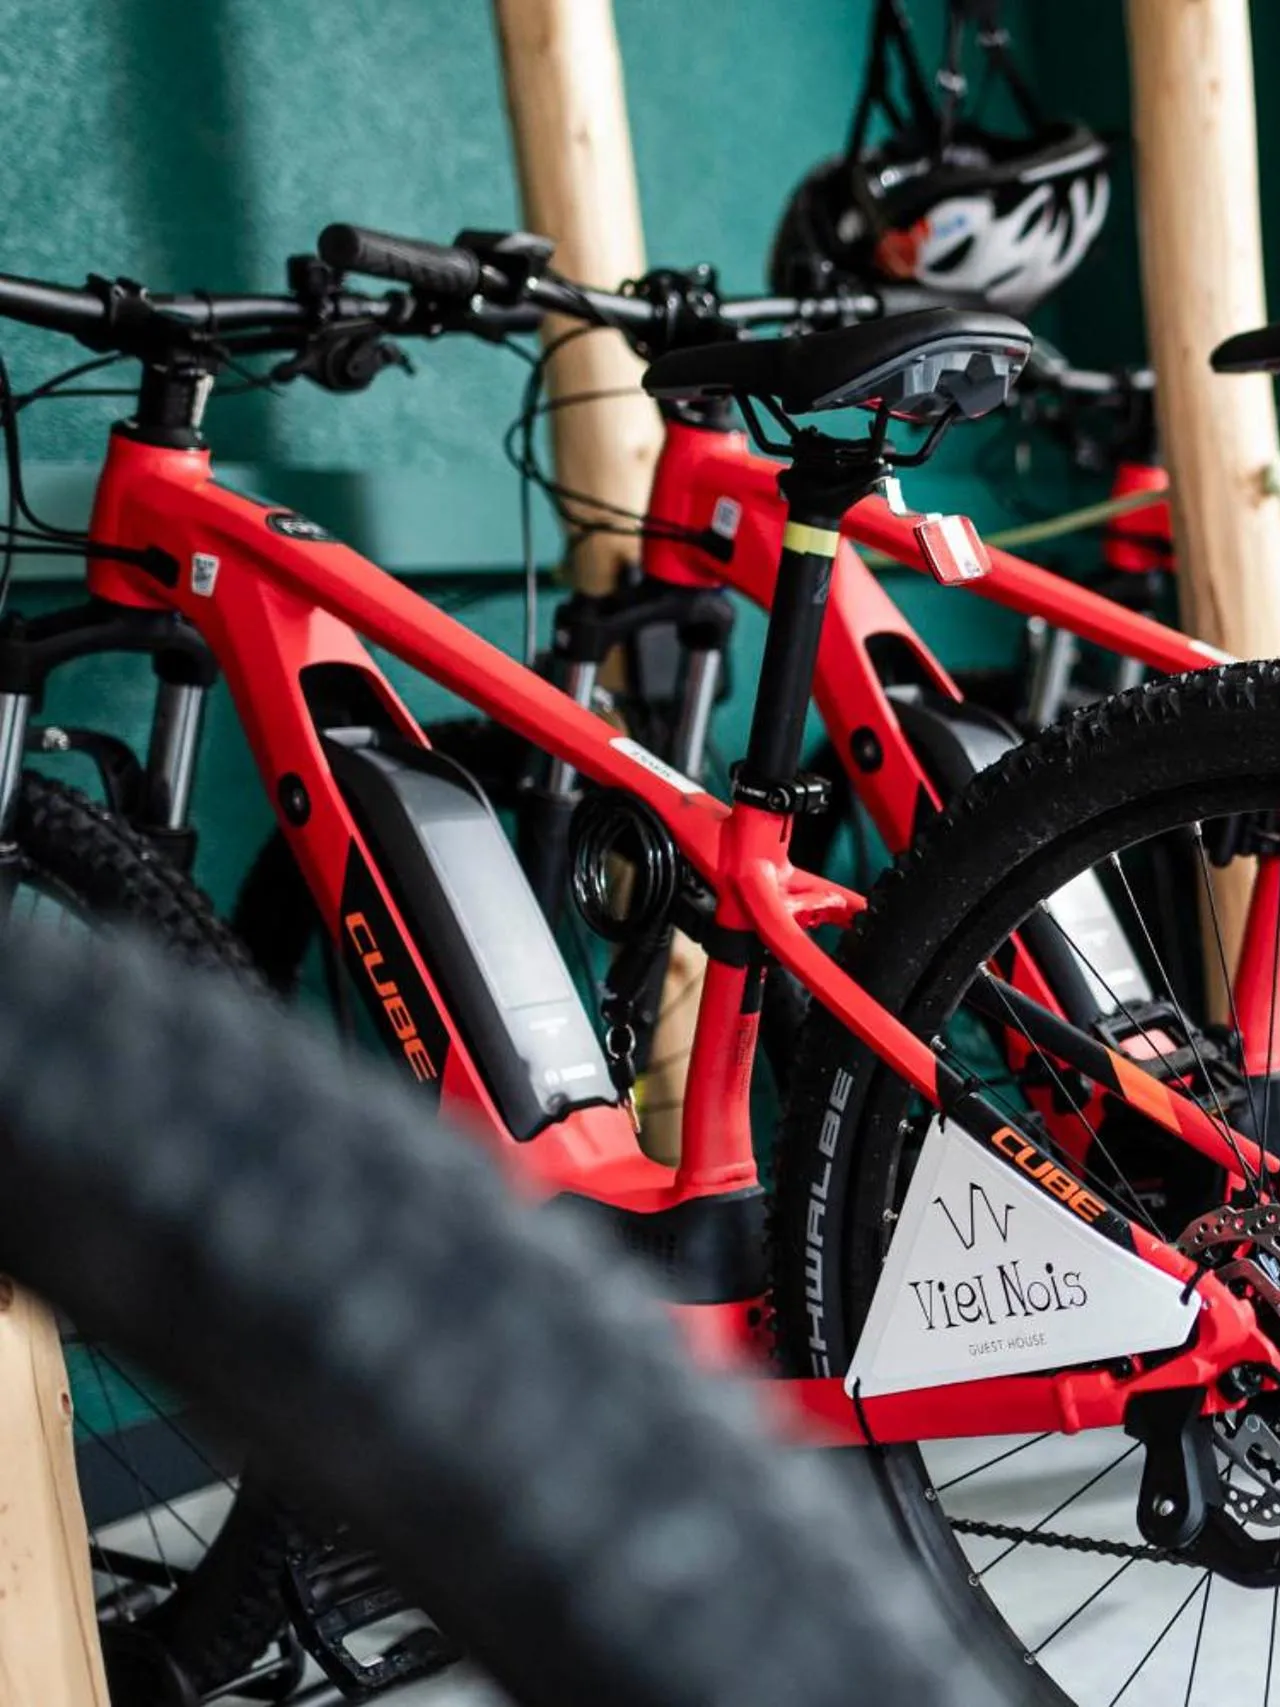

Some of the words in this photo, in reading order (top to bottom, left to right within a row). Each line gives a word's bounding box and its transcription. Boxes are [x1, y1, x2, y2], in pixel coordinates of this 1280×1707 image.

[344, 911, 438, 1083] CUBE
[805, 1066, 854, 1379] CHWALBE
[991, 1126, 1107, 1223] CUBE
[908, 1275, 996, 1330] Viel
[996, 1261, 1088, 1316] Nois
[968, 1338, 1004, 1357] GUEST
[1007, 1332, 1047, 1350] HOUSE
